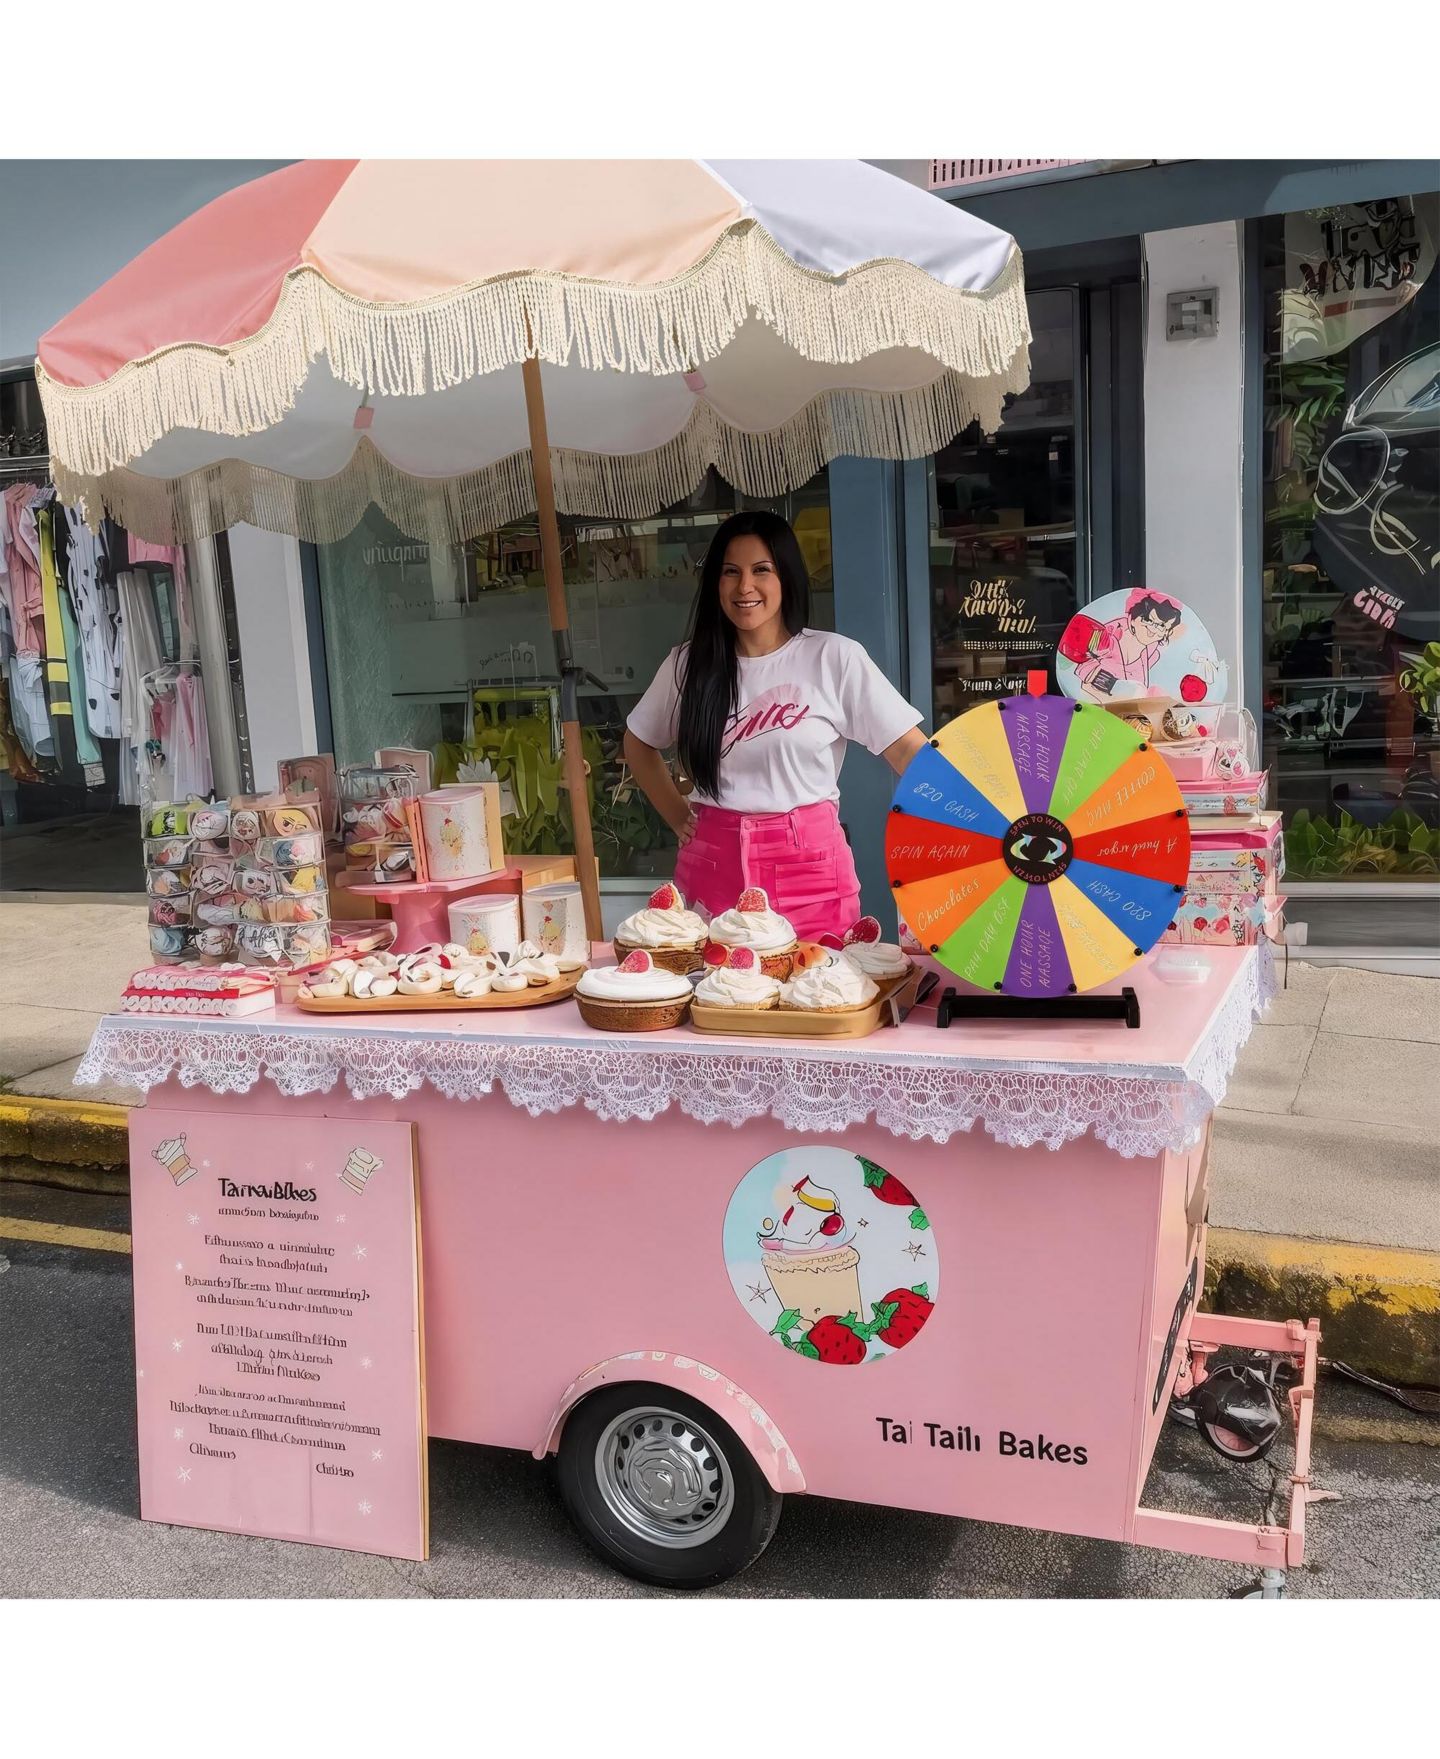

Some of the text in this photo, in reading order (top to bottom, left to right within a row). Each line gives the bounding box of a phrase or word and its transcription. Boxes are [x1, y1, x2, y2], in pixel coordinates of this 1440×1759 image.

[1045, 817, 1065, 832] WIN
[890, 844, 970, 862] SPIN AGAIN
[999, 1430, 1089, 1466] Bakes
